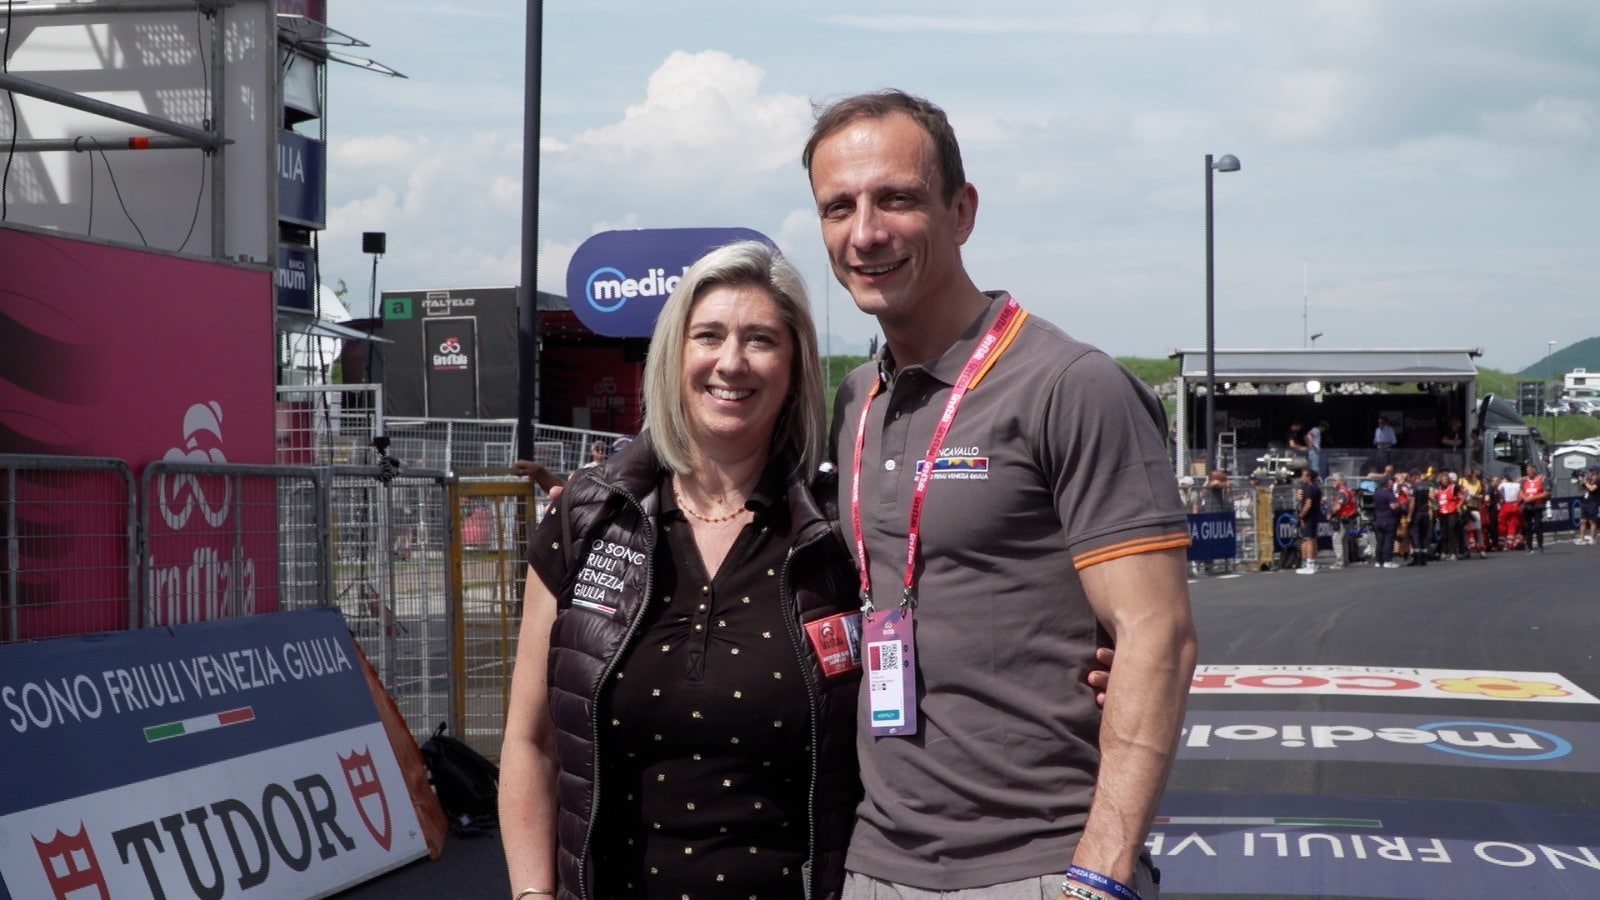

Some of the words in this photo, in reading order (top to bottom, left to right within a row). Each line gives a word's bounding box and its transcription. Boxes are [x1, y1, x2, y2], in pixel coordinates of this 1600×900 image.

[278, 268, 306, 290] num
[392, 302, 405, 314] a
[1201, 519, 1235, 540] GIULIA
[586, 553, 617, 572] RIULI
[574, 583, 606, 602] GIULIA
[2, 674, 102, 733] SONO
[102, 661, 186, 714] FRIULI
[180, 646, 287, 699] VENEZIA
[282, 636, 353, 680] GIULIA
[1182, 723, 1544, 750] mediol
[111, 773, 356, 900] TUDOR
[1244, 832, 1452, 863] FRIULI
